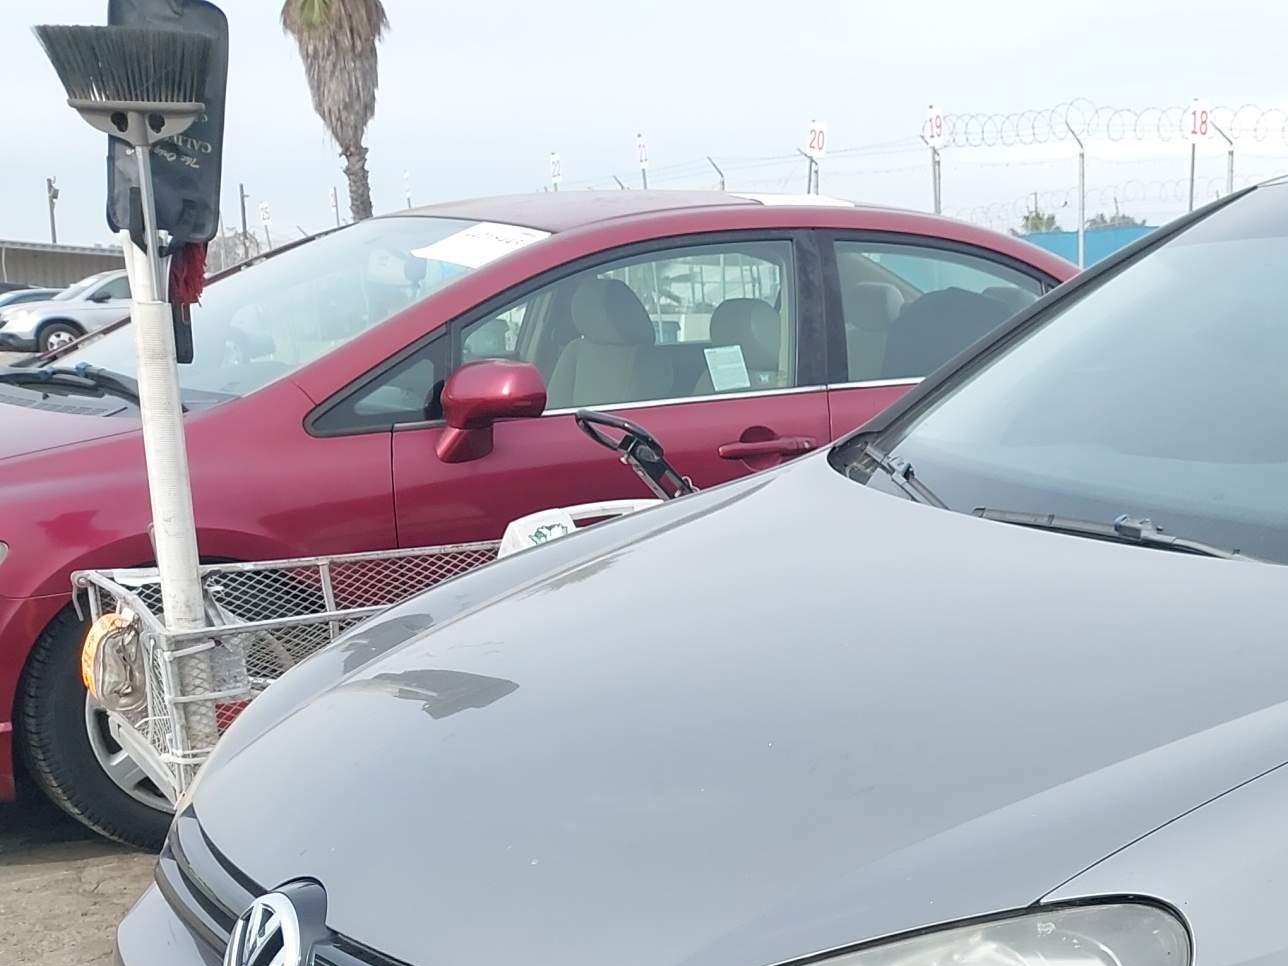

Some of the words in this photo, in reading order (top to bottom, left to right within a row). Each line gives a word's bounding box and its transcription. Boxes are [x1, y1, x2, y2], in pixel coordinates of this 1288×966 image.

[929, 114, 943, 138] 19
[1191, 110, 1208, 135] 18
[809, 129, 825, 150] 20
